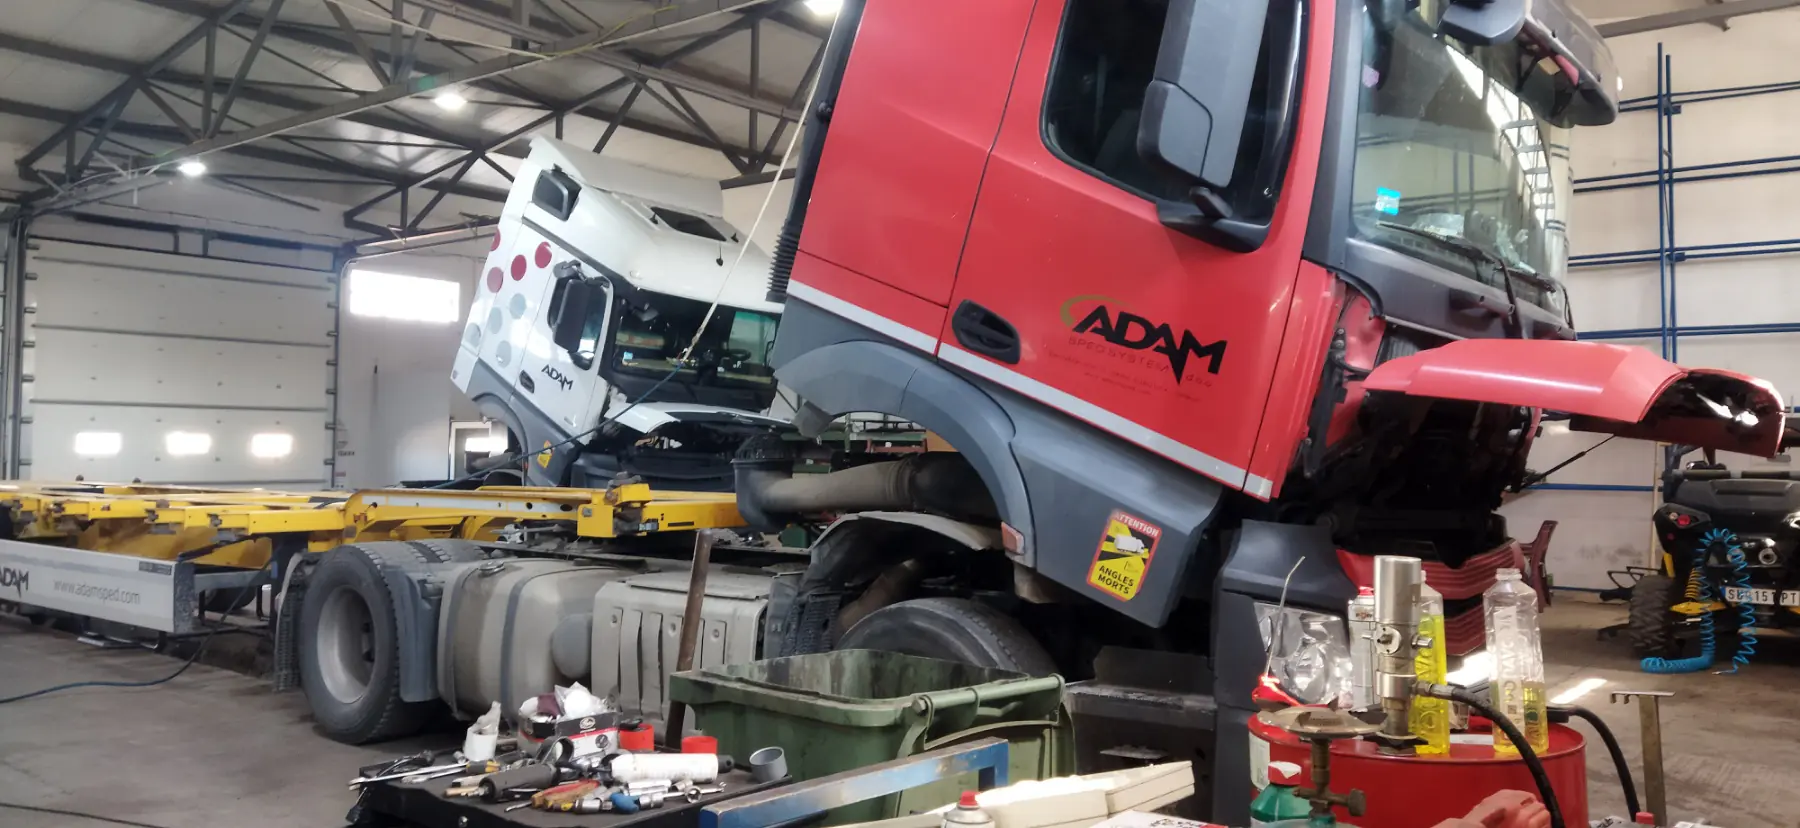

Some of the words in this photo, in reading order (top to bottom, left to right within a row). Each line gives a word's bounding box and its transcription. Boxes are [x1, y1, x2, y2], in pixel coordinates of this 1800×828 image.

[1072, 304, 1228, 386] ADAM
[541, 364, 573, 391] ADAM
[1097, 574, 1130, 594] MORTS
[1099, 565, 1134, 587] ANGLES
[53, 579, 141, 605] www.adamsped.com
[1781, 592, 1797, 605] PT
